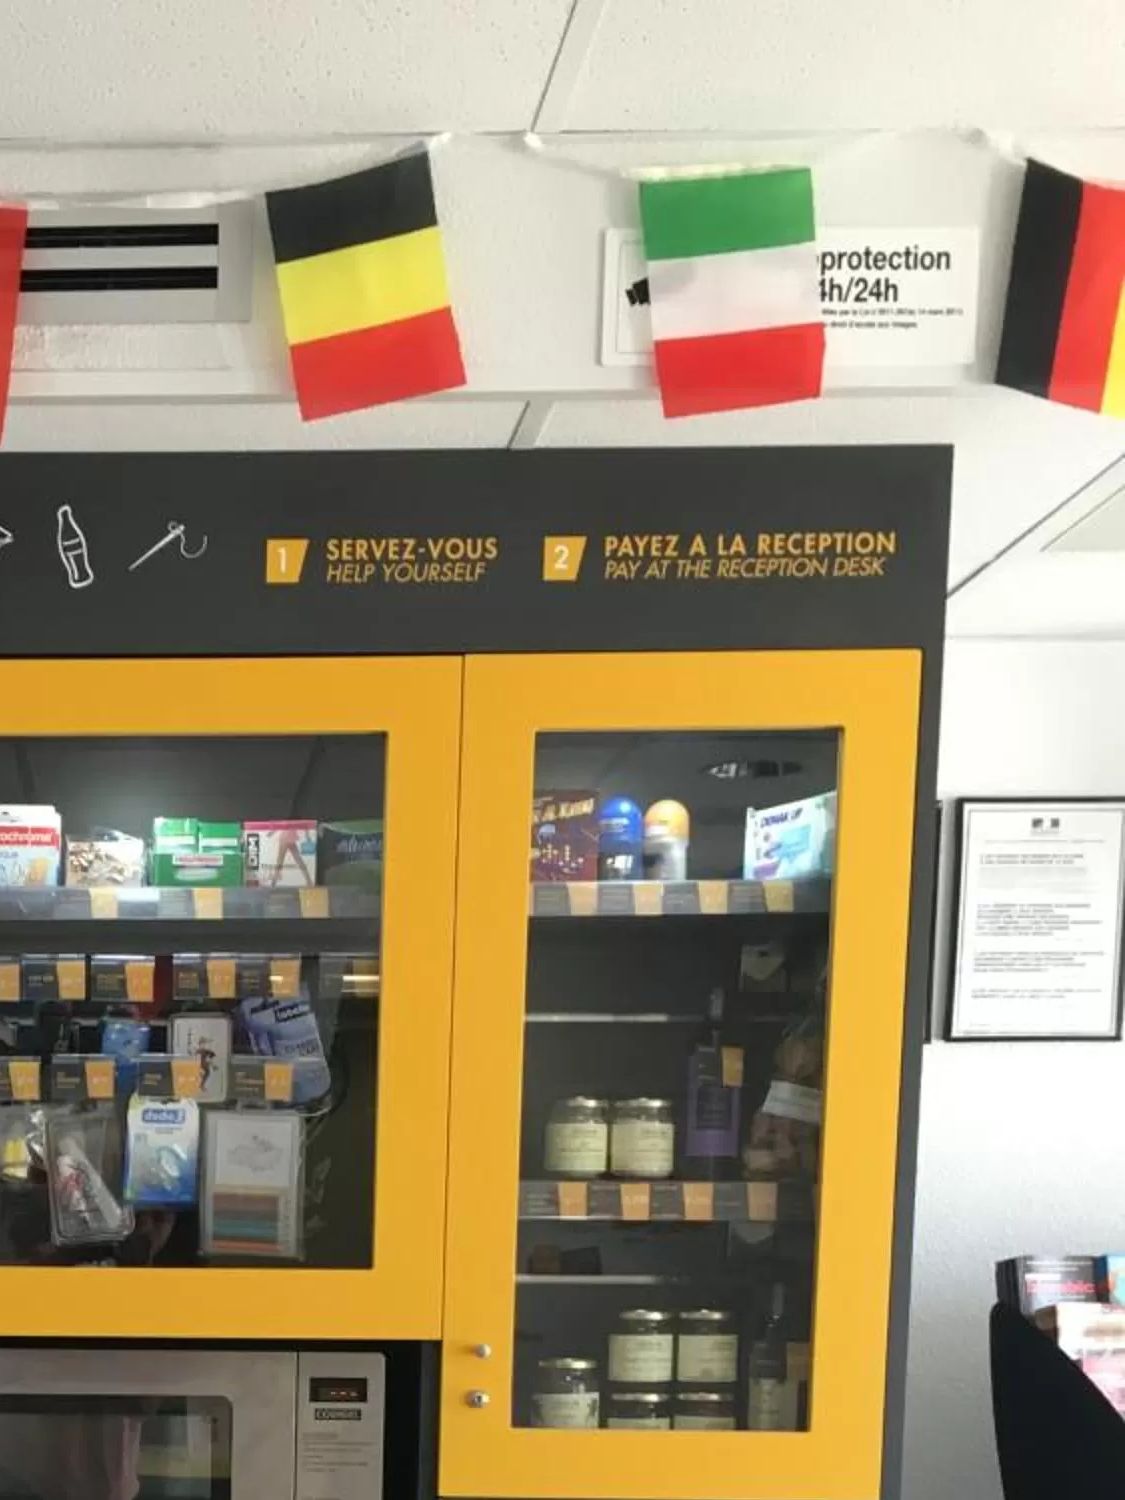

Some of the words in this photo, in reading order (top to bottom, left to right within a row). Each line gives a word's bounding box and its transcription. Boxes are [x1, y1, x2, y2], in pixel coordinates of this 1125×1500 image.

[817, 245, 951, 276] protection
[819, 277, 899, 302] 4h/24h
[326, 537, 499, 562] SERVEZ-VOUS
[604, 534, 679, 558] PAYEZ
[690, 535, 707, 556] A
[718, 534, 749, 556] LA
[757, 531, 897, 556] RECEPTION
[276, 546, 288, 573] 1
[553, 545, 570, 570] 2
[604, 558, 641, 581] PAY
[643, 558, 673, 580] AT
[675, 557, 712, 580] THE
[715, 557, 828, 579] RECEPTION
[831, 555, 887, 577] DESK
[325, 561, 376, 584] HELP
[382, 560, 488, 583] YOURSELF
